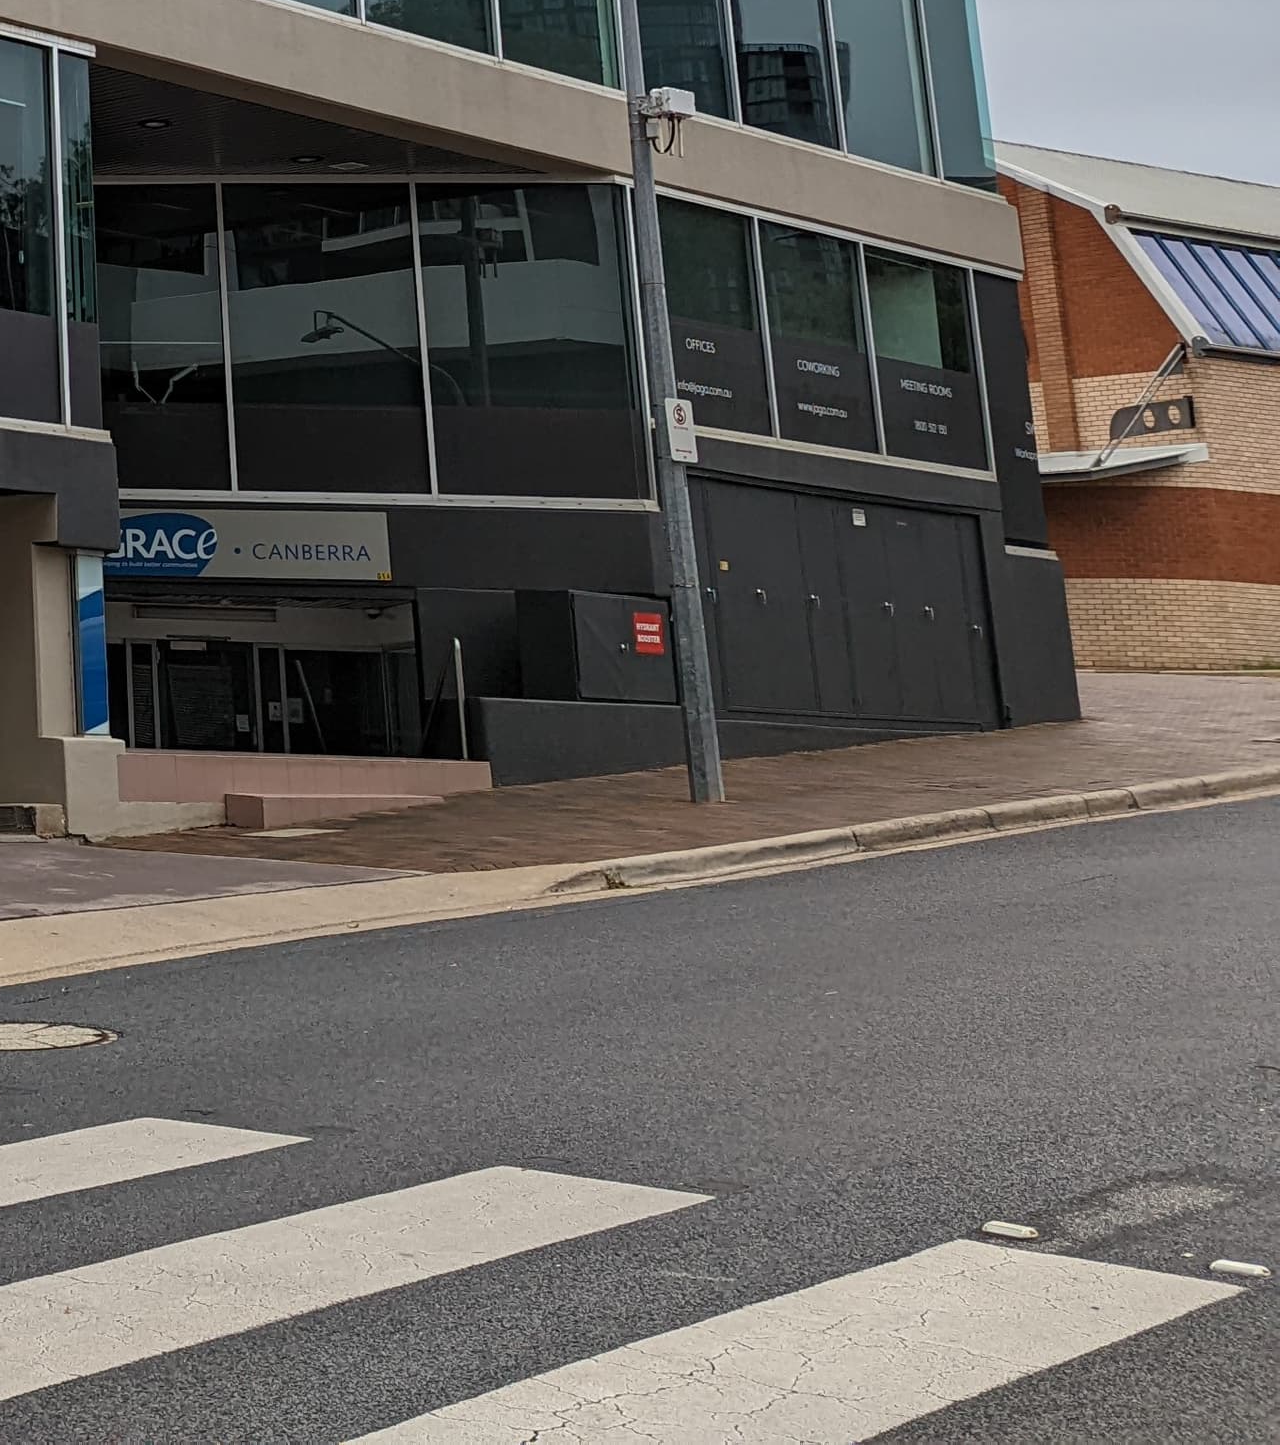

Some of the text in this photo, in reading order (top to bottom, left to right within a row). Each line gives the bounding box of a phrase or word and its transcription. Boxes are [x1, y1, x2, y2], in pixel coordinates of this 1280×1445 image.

[685, 338, 716, 354] OFFICES
[796, 359, 840, 378] COWORKING
[900, 378, 953, 398] MEETING ROOMS
[252, 543, 371, 561] CANBERRA
